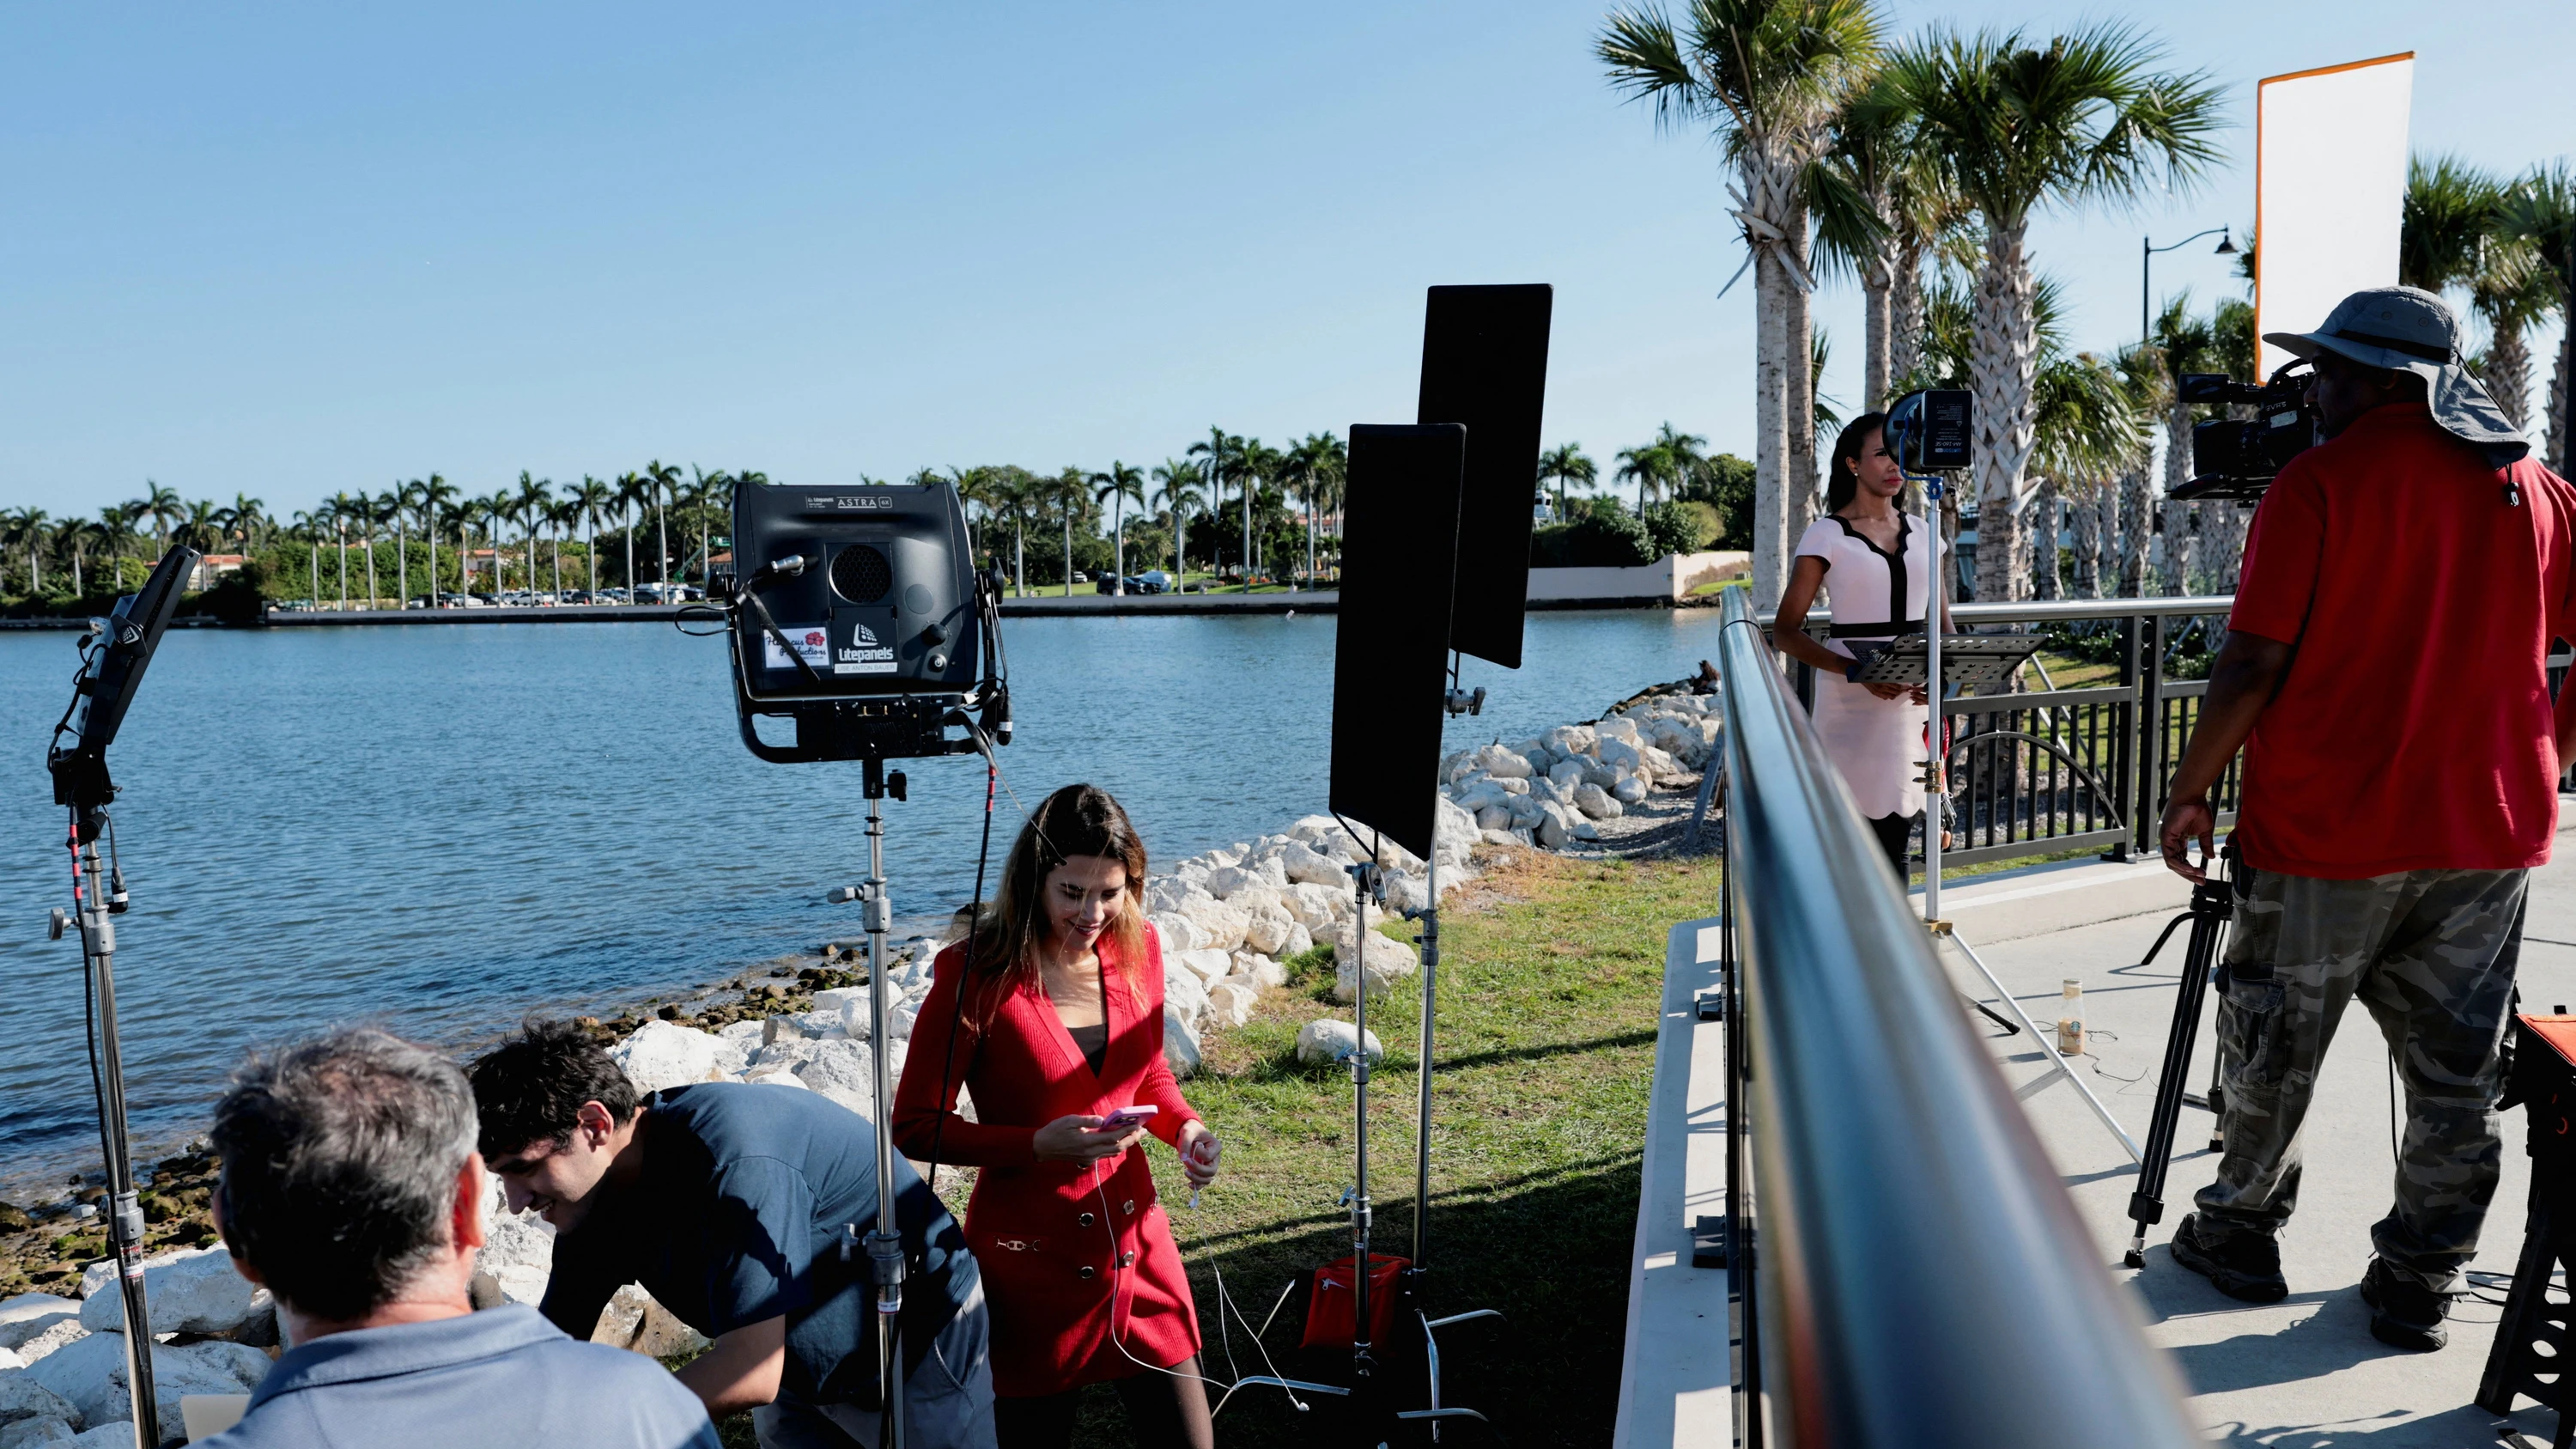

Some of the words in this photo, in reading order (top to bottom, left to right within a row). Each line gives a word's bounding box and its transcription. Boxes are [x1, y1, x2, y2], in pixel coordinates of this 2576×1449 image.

[838, 498, 877, 507] ASTRA
[766, 636, 805, 646] Hicus
[780, 646, 827, 657] Puctions
[838, 647, 894, 663] Litepanels
